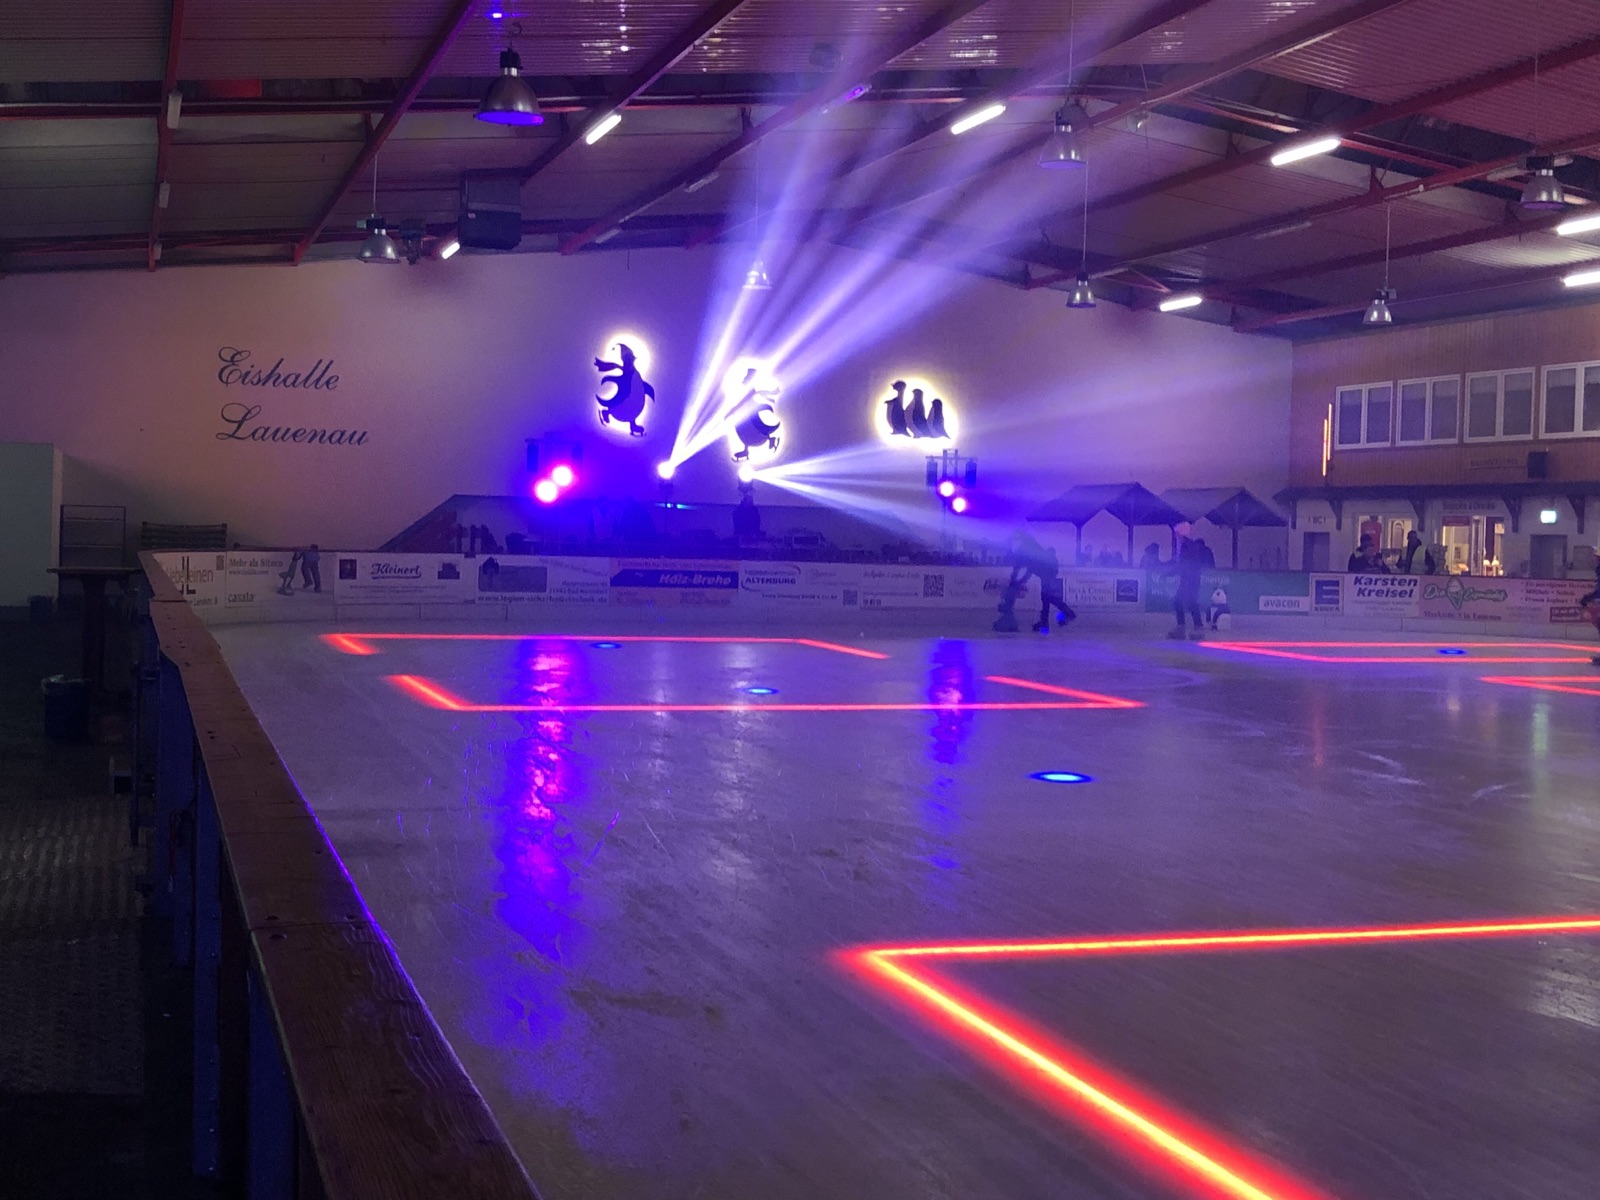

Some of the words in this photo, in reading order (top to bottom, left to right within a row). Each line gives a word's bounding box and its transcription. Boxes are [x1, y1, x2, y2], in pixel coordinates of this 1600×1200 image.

[218, 346, 340, 390] Eishalle
[215, 402, 368, 446] Lauenau
[370, 562, 422, 578] Kleinert
[1353, 575, 1419, 587] Karsten
[228, 592, 254, 603] casala
[1356, 587, 1414, 598] Kreisel
[1263, 598, 1300, 608] avacon
